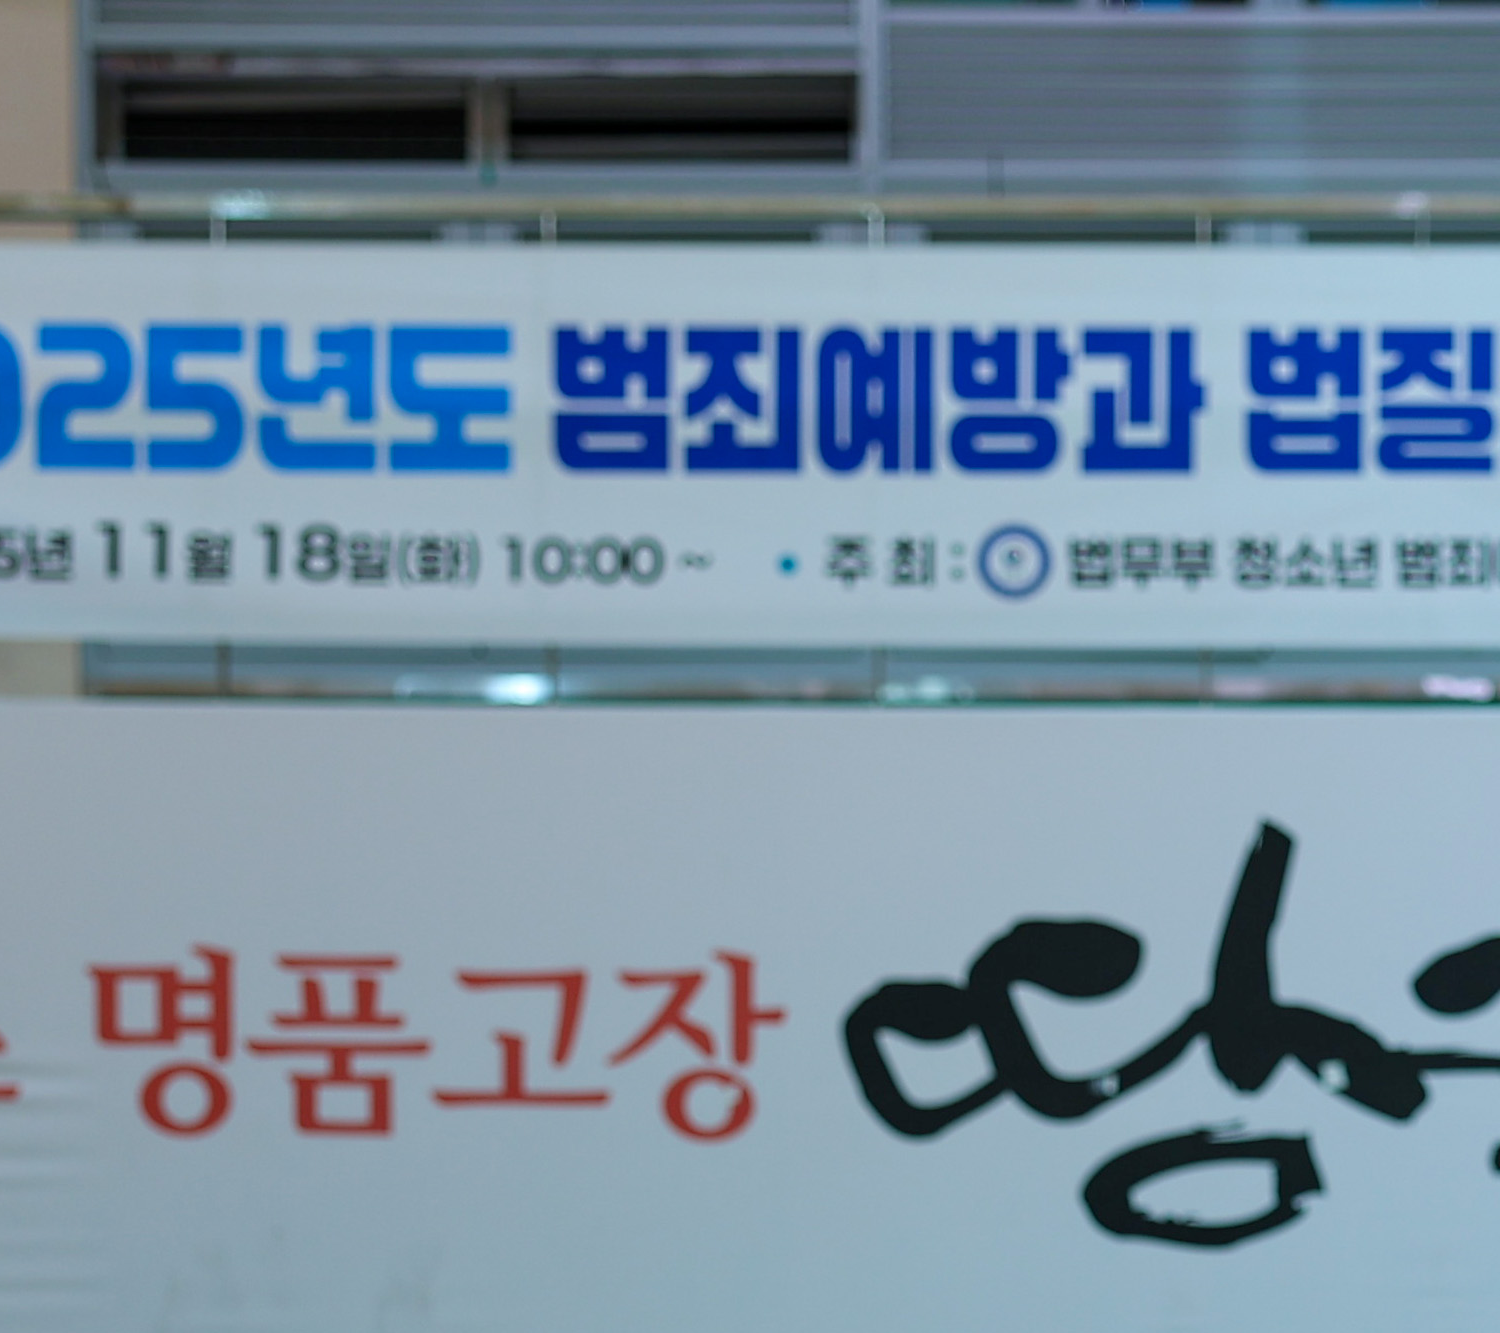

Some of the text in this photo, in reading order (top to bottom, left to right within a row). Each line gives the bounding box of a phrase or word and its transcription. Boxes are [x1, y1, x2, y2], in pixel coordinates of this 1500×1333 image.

[553, 321, 1206, 476] 범죄예방과
[98, 522, 232, 585] 11월
[256, 522, 481, 586] 18일(화)
[501, 533, 666, 586] 10:00
[1067, 536, 1217, 590] 법무부
[1234, 536, 1380, 590] 청소년
[86, 943, 786, 1141] 명품고장
